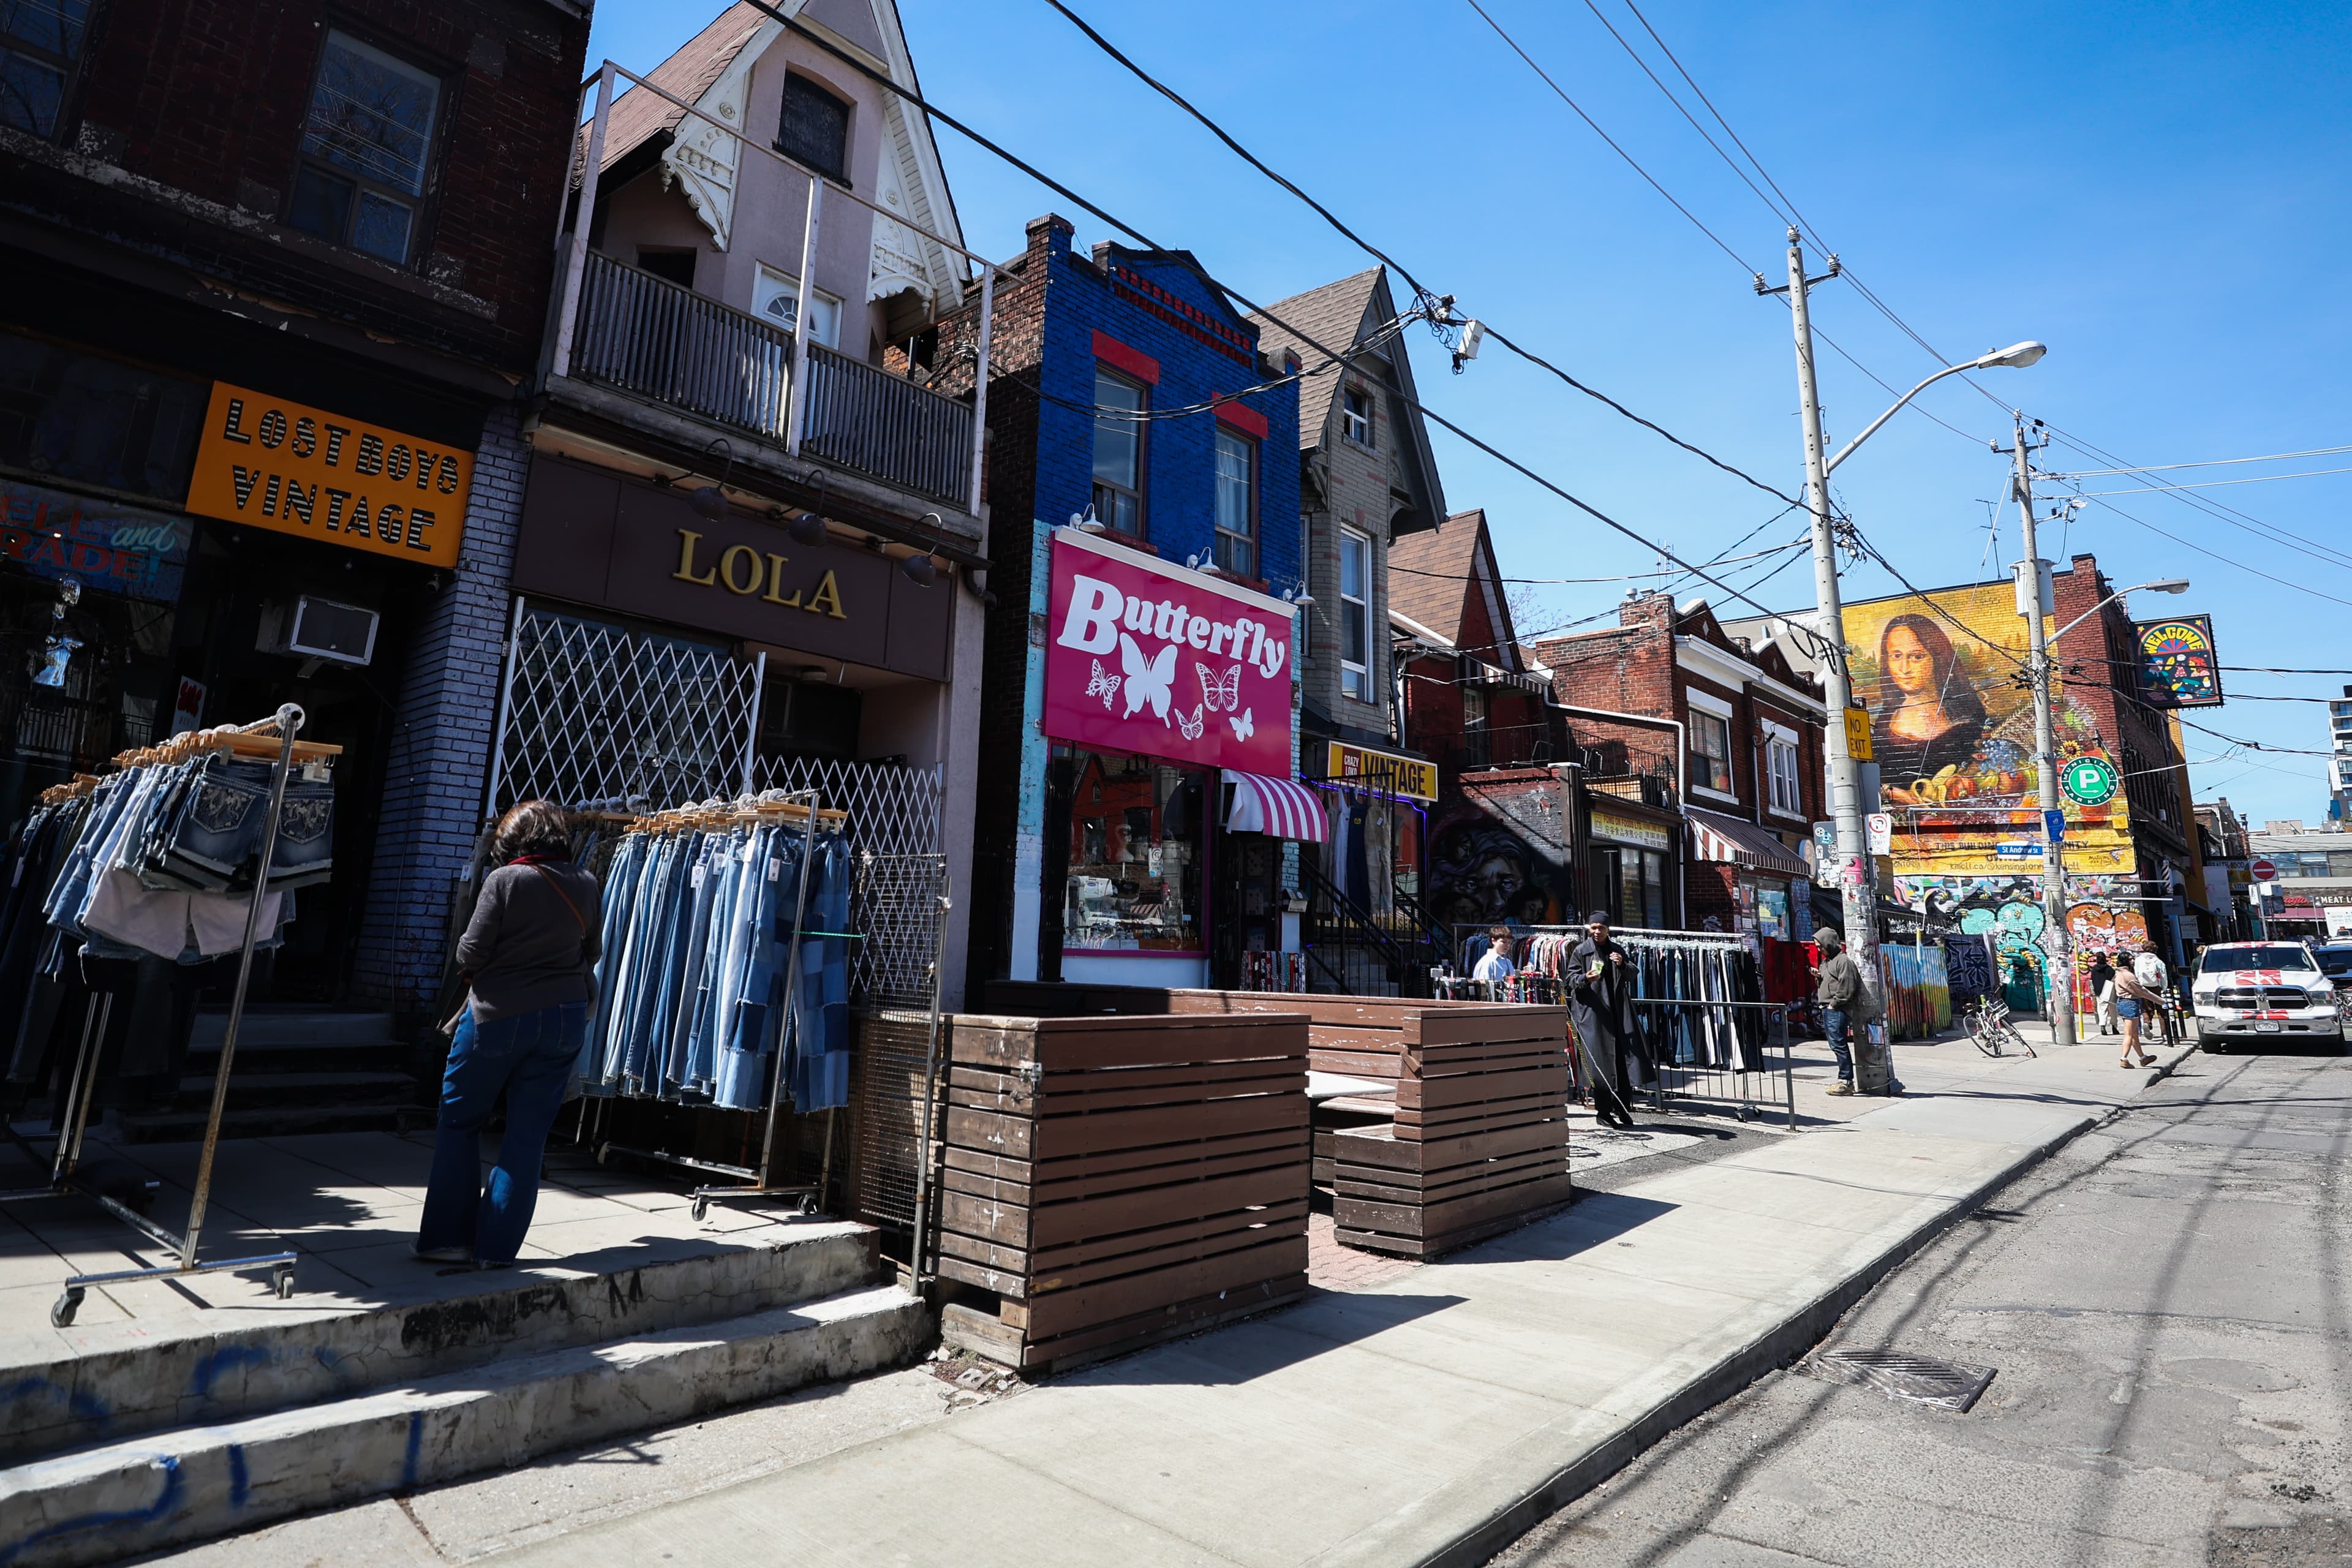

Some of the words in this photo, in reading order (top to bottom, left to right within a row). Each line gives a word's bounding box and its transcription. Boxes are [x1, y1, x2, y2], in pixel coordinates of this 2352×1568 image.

[223, 398, 351, 468] LOST
[355, 435, 458, 495] BOYS
[232, 465, 436, 552] VINTAGE
[110, 521, 177, 552] and
[671, 529, 847, 620] LOLA
[1057, 574, 1285, 679] Butterfly
[2144, 627, 2204, 654] WELCOME
[1850, 718, 1861, 733] NO
[1850, 737, 1866, 753] EXIT
[1344, 755, 1359, 767] CRAZY
[1364, 753, 1426, 796] VINTAGE
[2064, 759, 2114, 780] MUNICIPAL
[2079, 769, 2100, 788] P
[2064, 785, 2115, 804] PARKING
